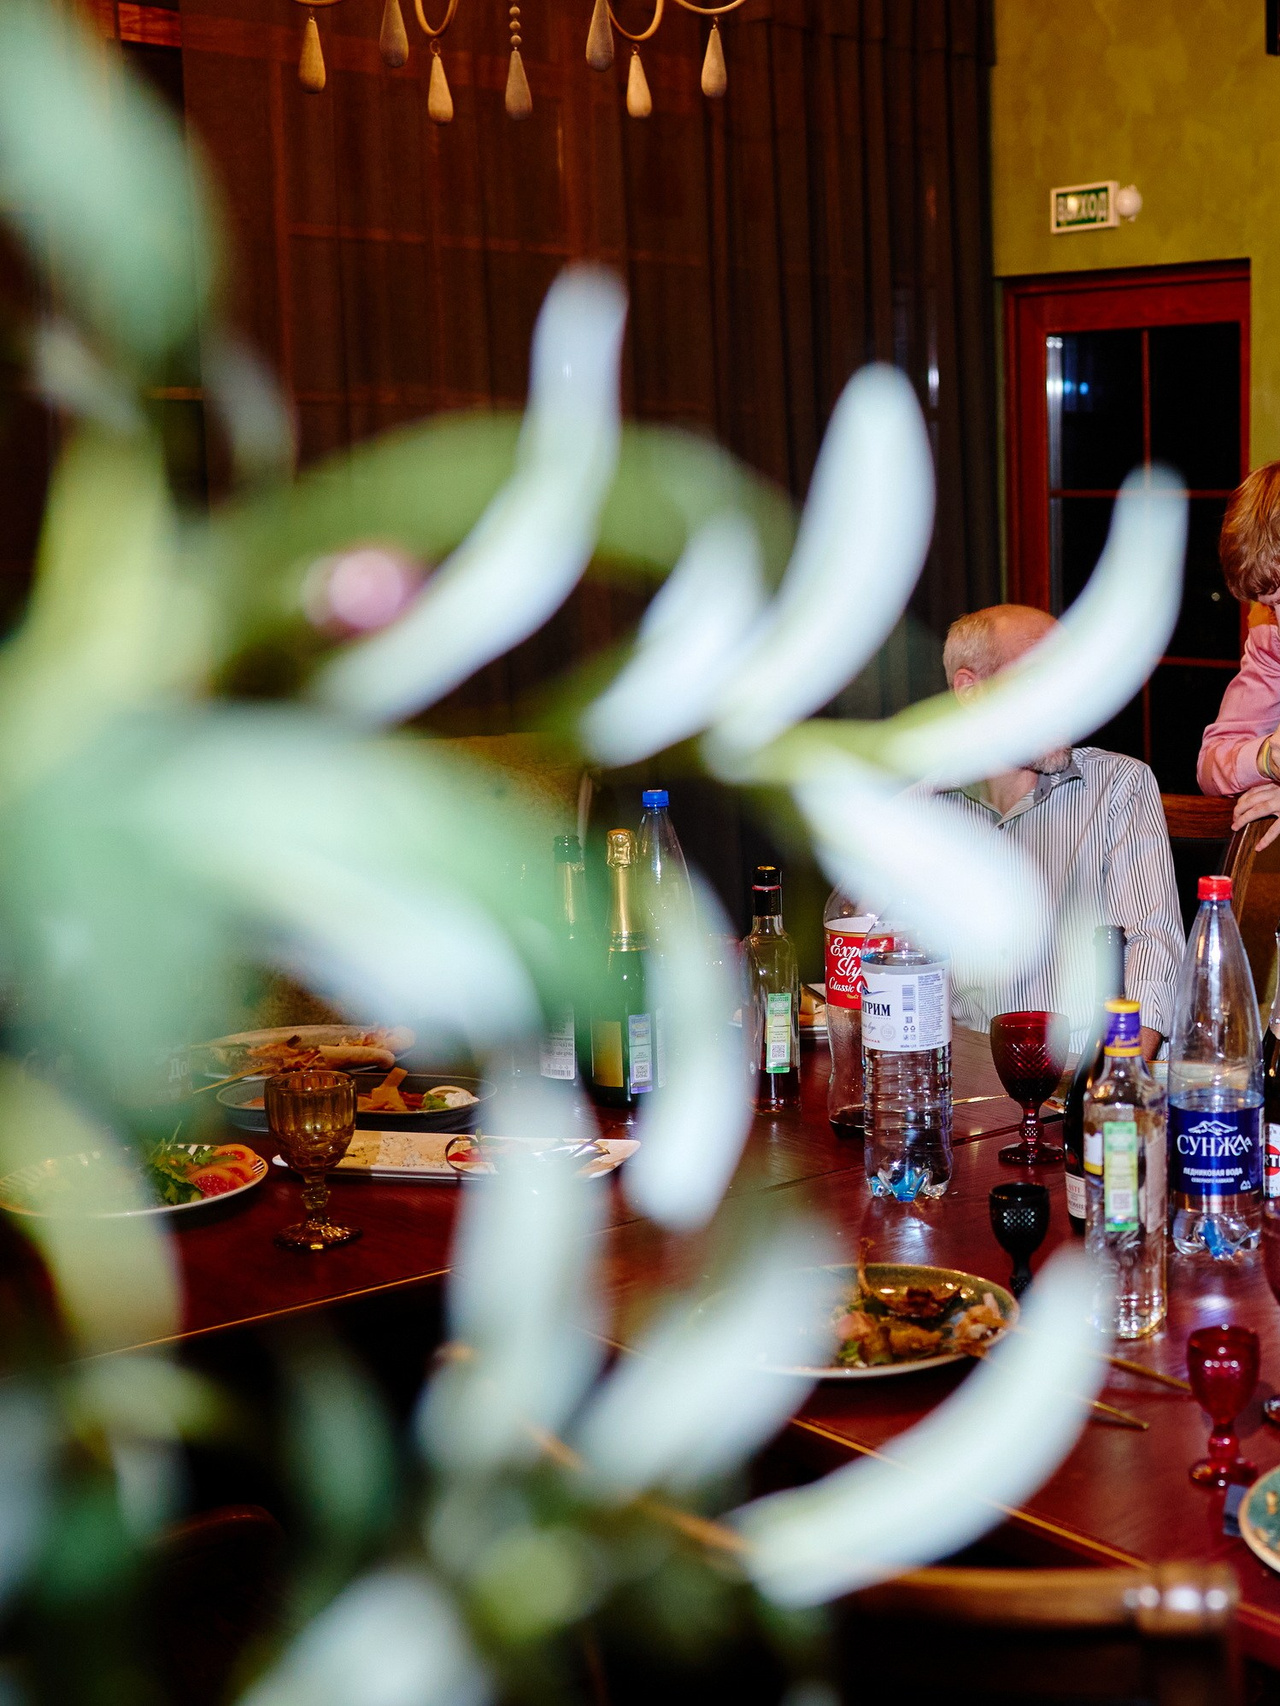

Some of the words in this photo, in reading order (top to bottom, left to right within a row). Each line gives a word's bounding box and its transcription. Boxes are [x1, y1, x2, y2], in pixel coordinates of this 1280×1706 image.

[828, 976, 855, 993] Classic
[1183, 1167, 1225, 1177] ЛЕДНИКОВАЯ
[1226, 1167, 1243, 1177] ВОДА
